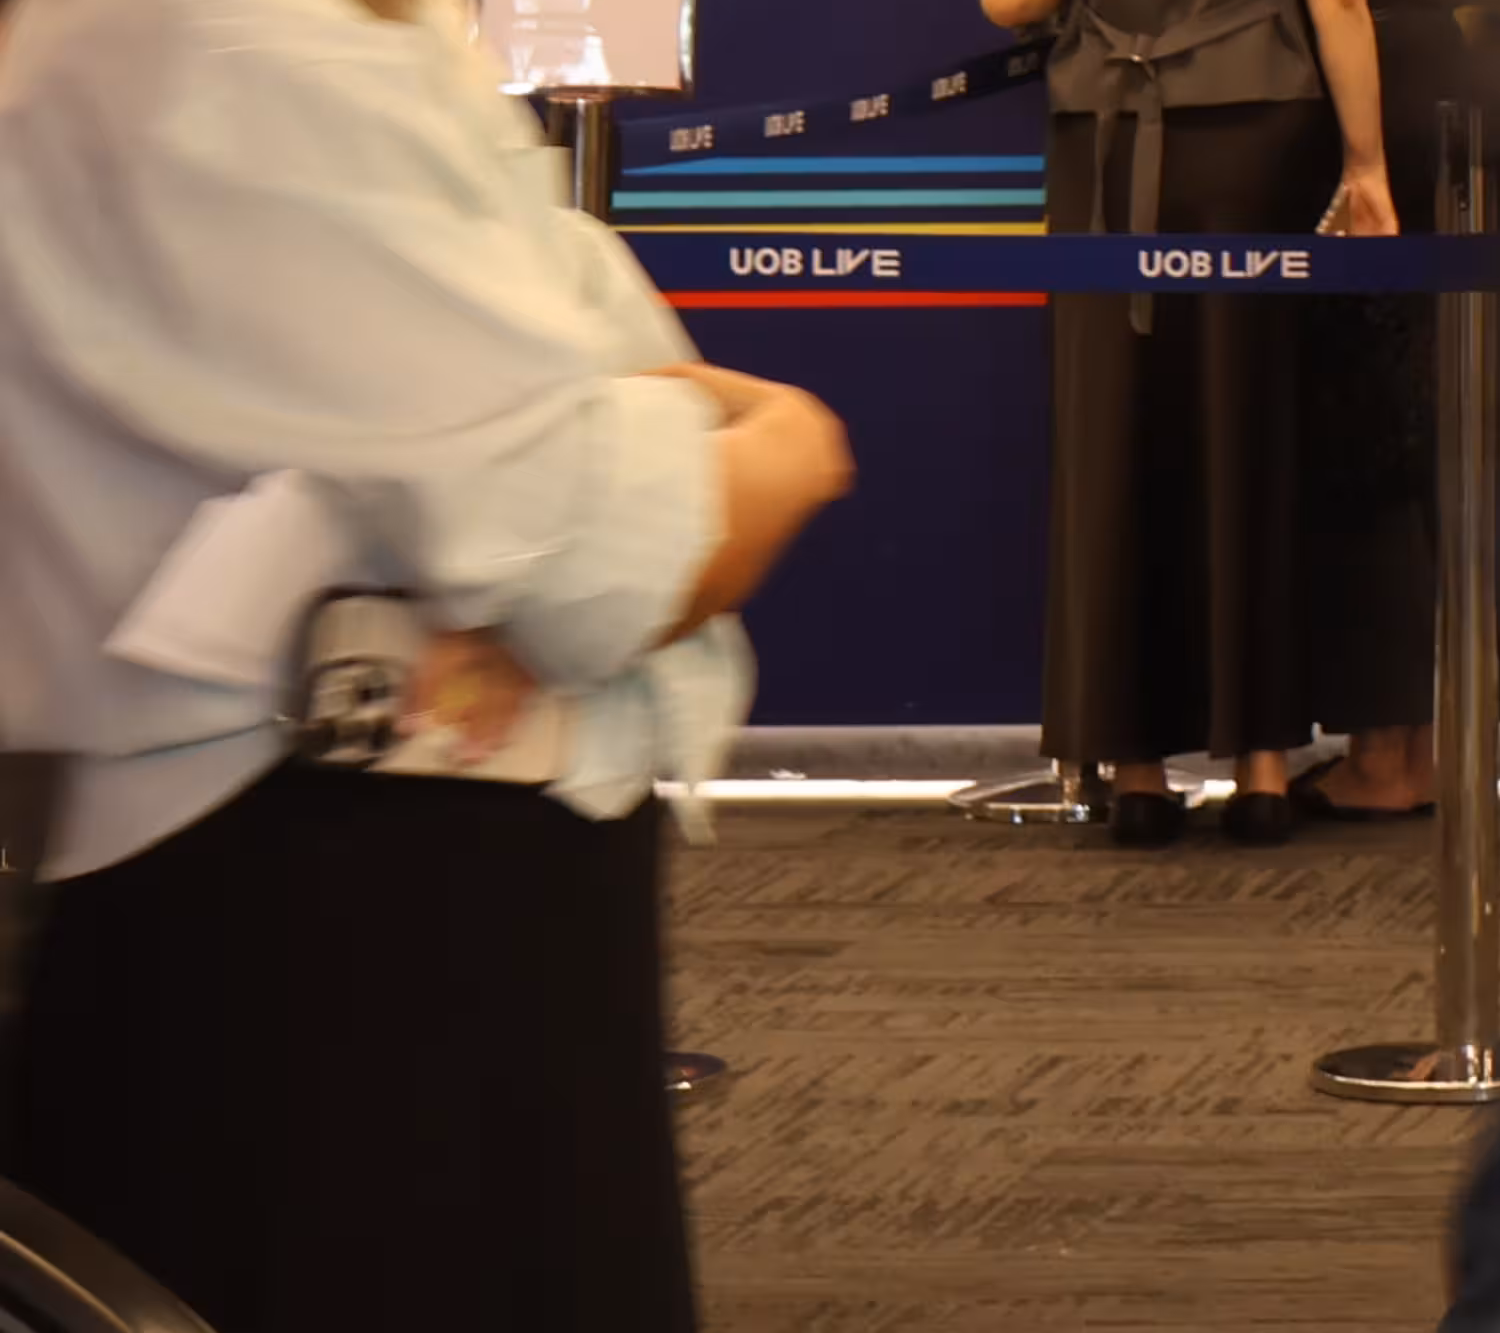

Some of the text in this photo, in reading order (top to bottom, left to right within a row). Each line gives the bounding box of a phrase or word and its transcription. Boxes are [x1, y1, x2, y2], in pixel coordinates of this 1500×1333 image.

[730, 248, 900, 277] UOB LIVE
[1138, 250, 1310, 278] UOB LIVE
